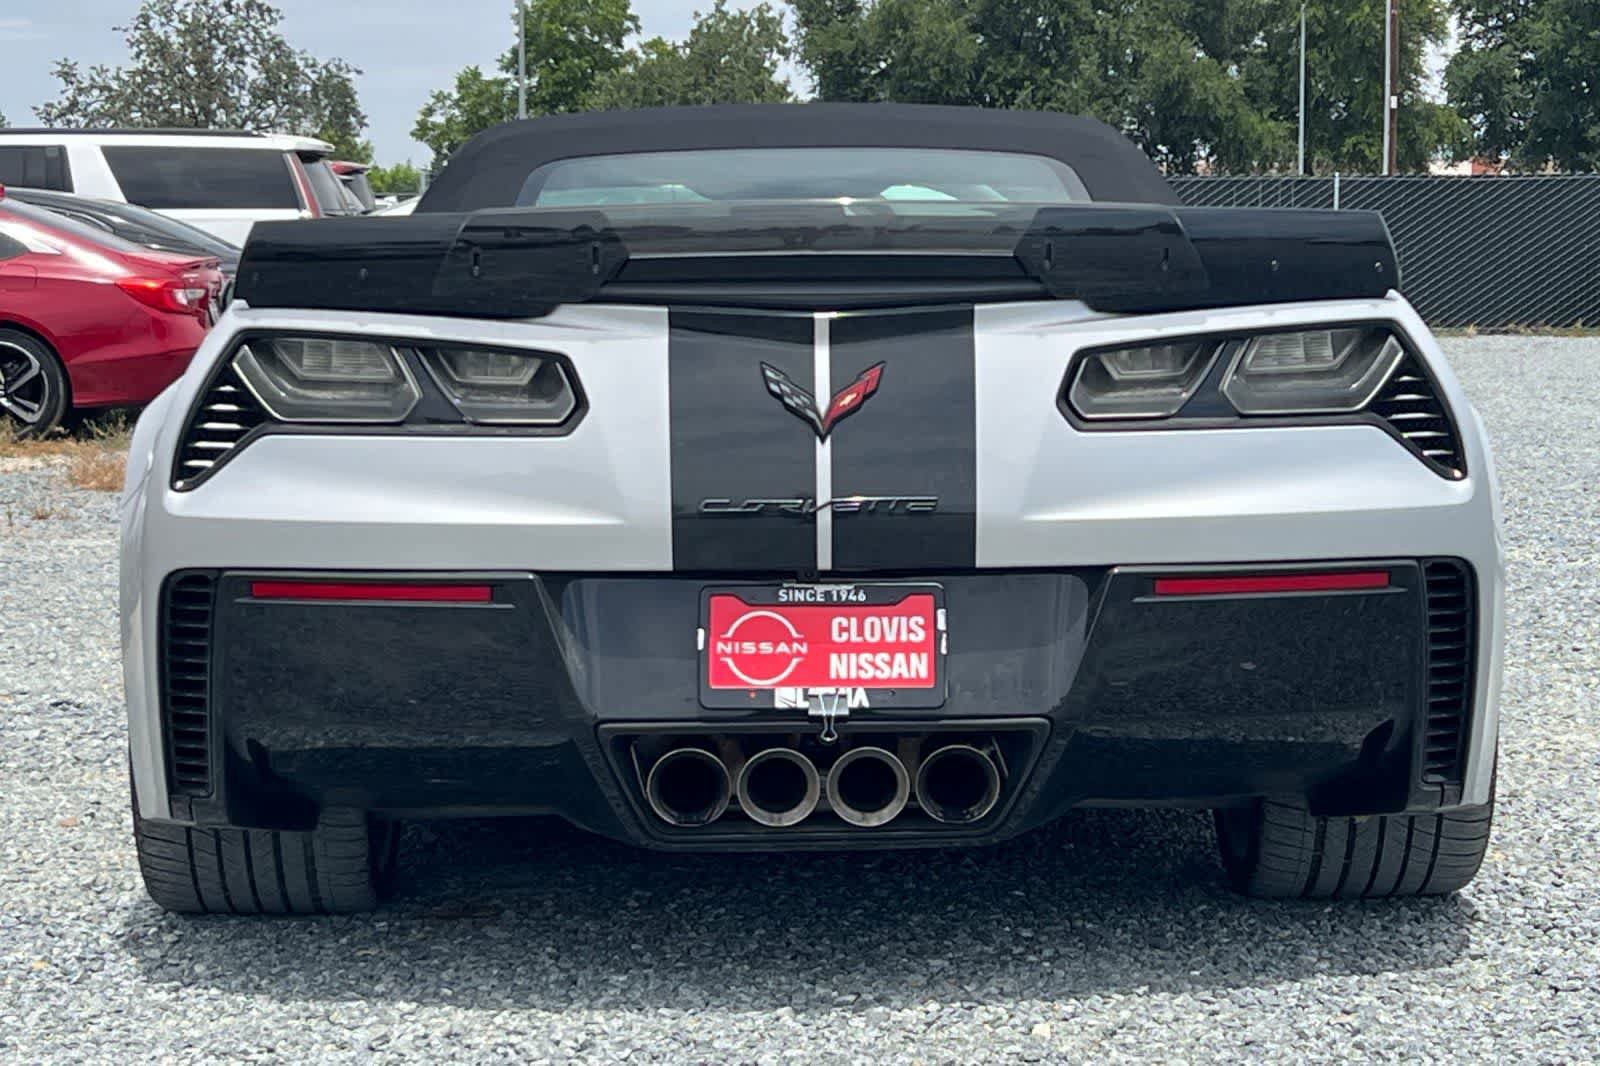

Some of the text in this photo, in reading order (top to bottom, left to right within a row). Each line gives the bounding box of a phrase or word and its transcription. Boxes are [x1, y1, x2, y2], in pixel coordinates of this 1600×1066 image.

[700, 496, 938, 514] CORVETTE
[778, 589, 866, 602] SINCE 1946
[831, 616, 925, 643] CLOVIS
[716, 641, 808, 654] NISSAN
[829, 652, 928, 680] NISSAN
